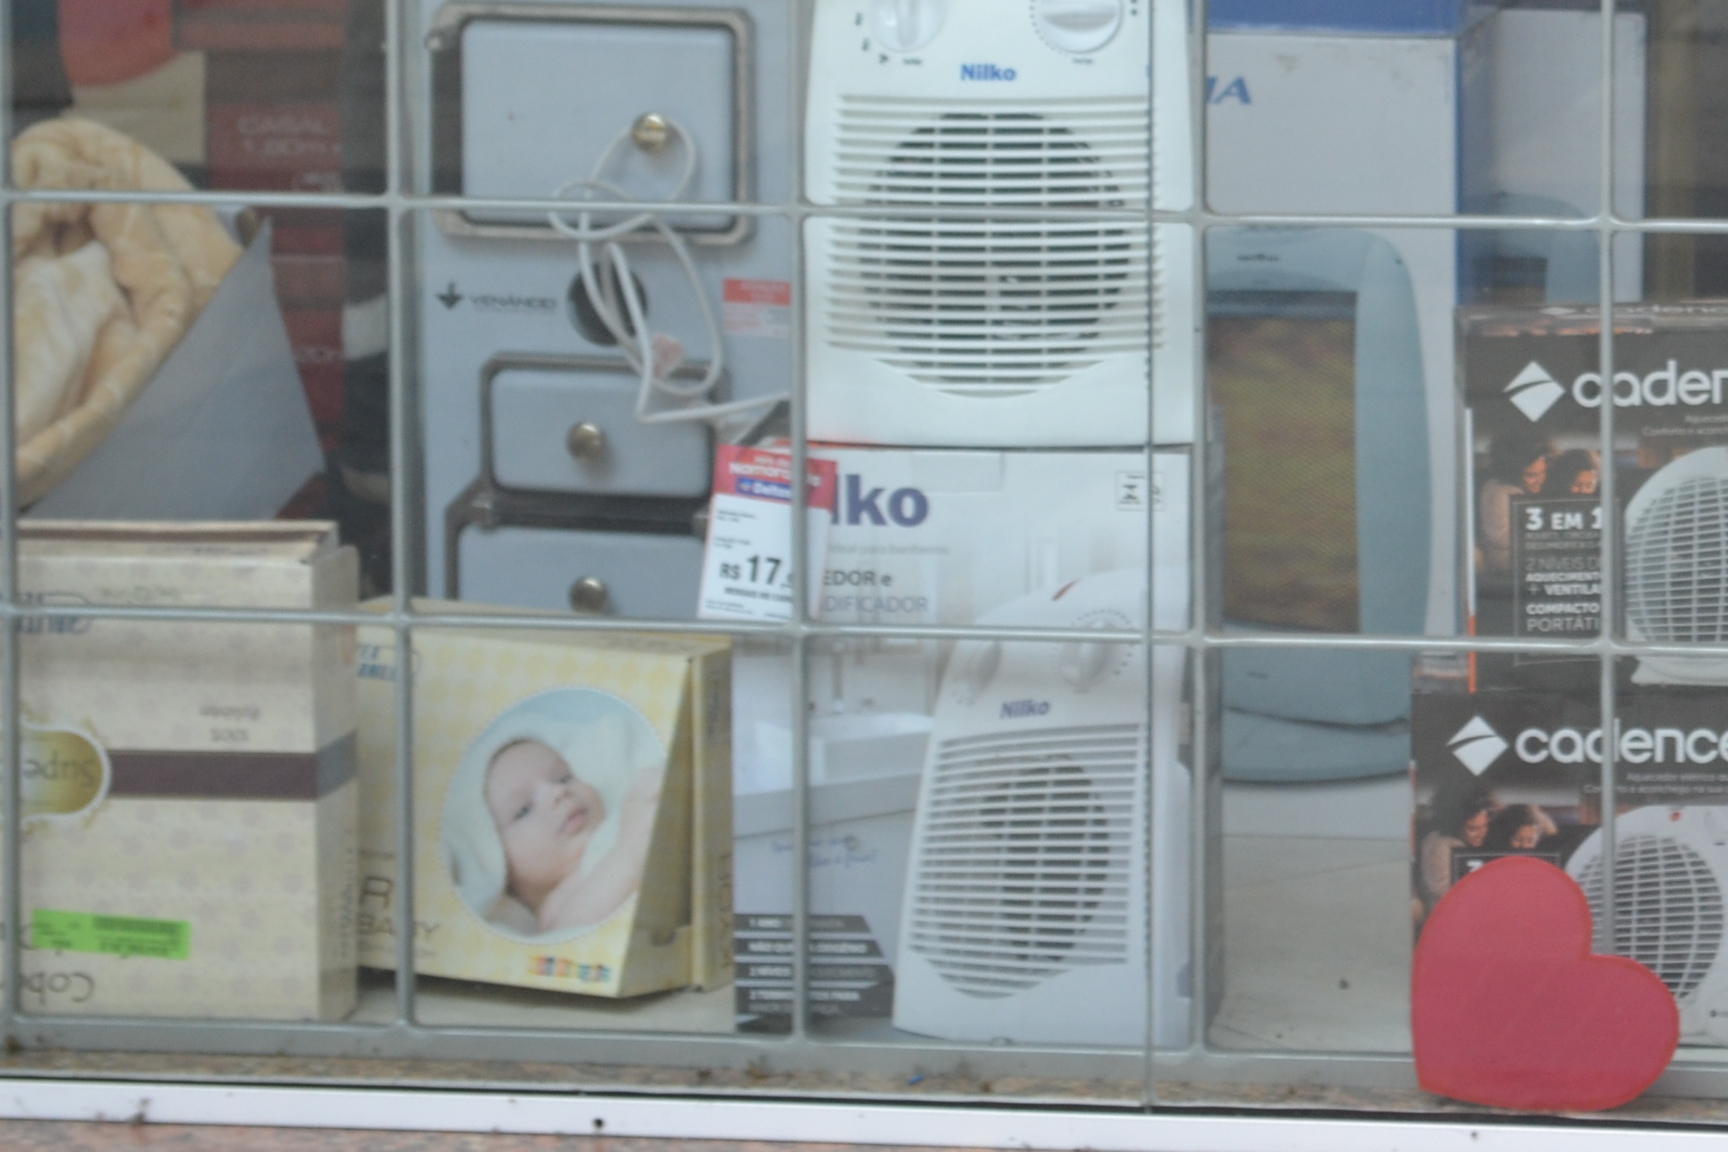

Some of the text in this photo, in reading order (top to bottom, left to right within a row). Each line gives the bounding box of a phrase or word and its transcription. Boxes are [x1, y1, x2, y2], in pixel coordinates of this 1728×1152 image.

[959, 62, 1018, 83] Nilko
[1525, 506, 1608, 531] 3 EM 1
[1525, 570, 1600, 583] AQUECIMENT
[1543, 582, 1600, 596] VENTILA
[825, 596, 928, 614] DIFICADOR
[1526, 602, 1600, 615] COMPACTO
[1527, 614, 1600, 633] PORTÁTI
[1000, 698, 1052, 720] Nilko
[22, 750, 97, 788] Supe
